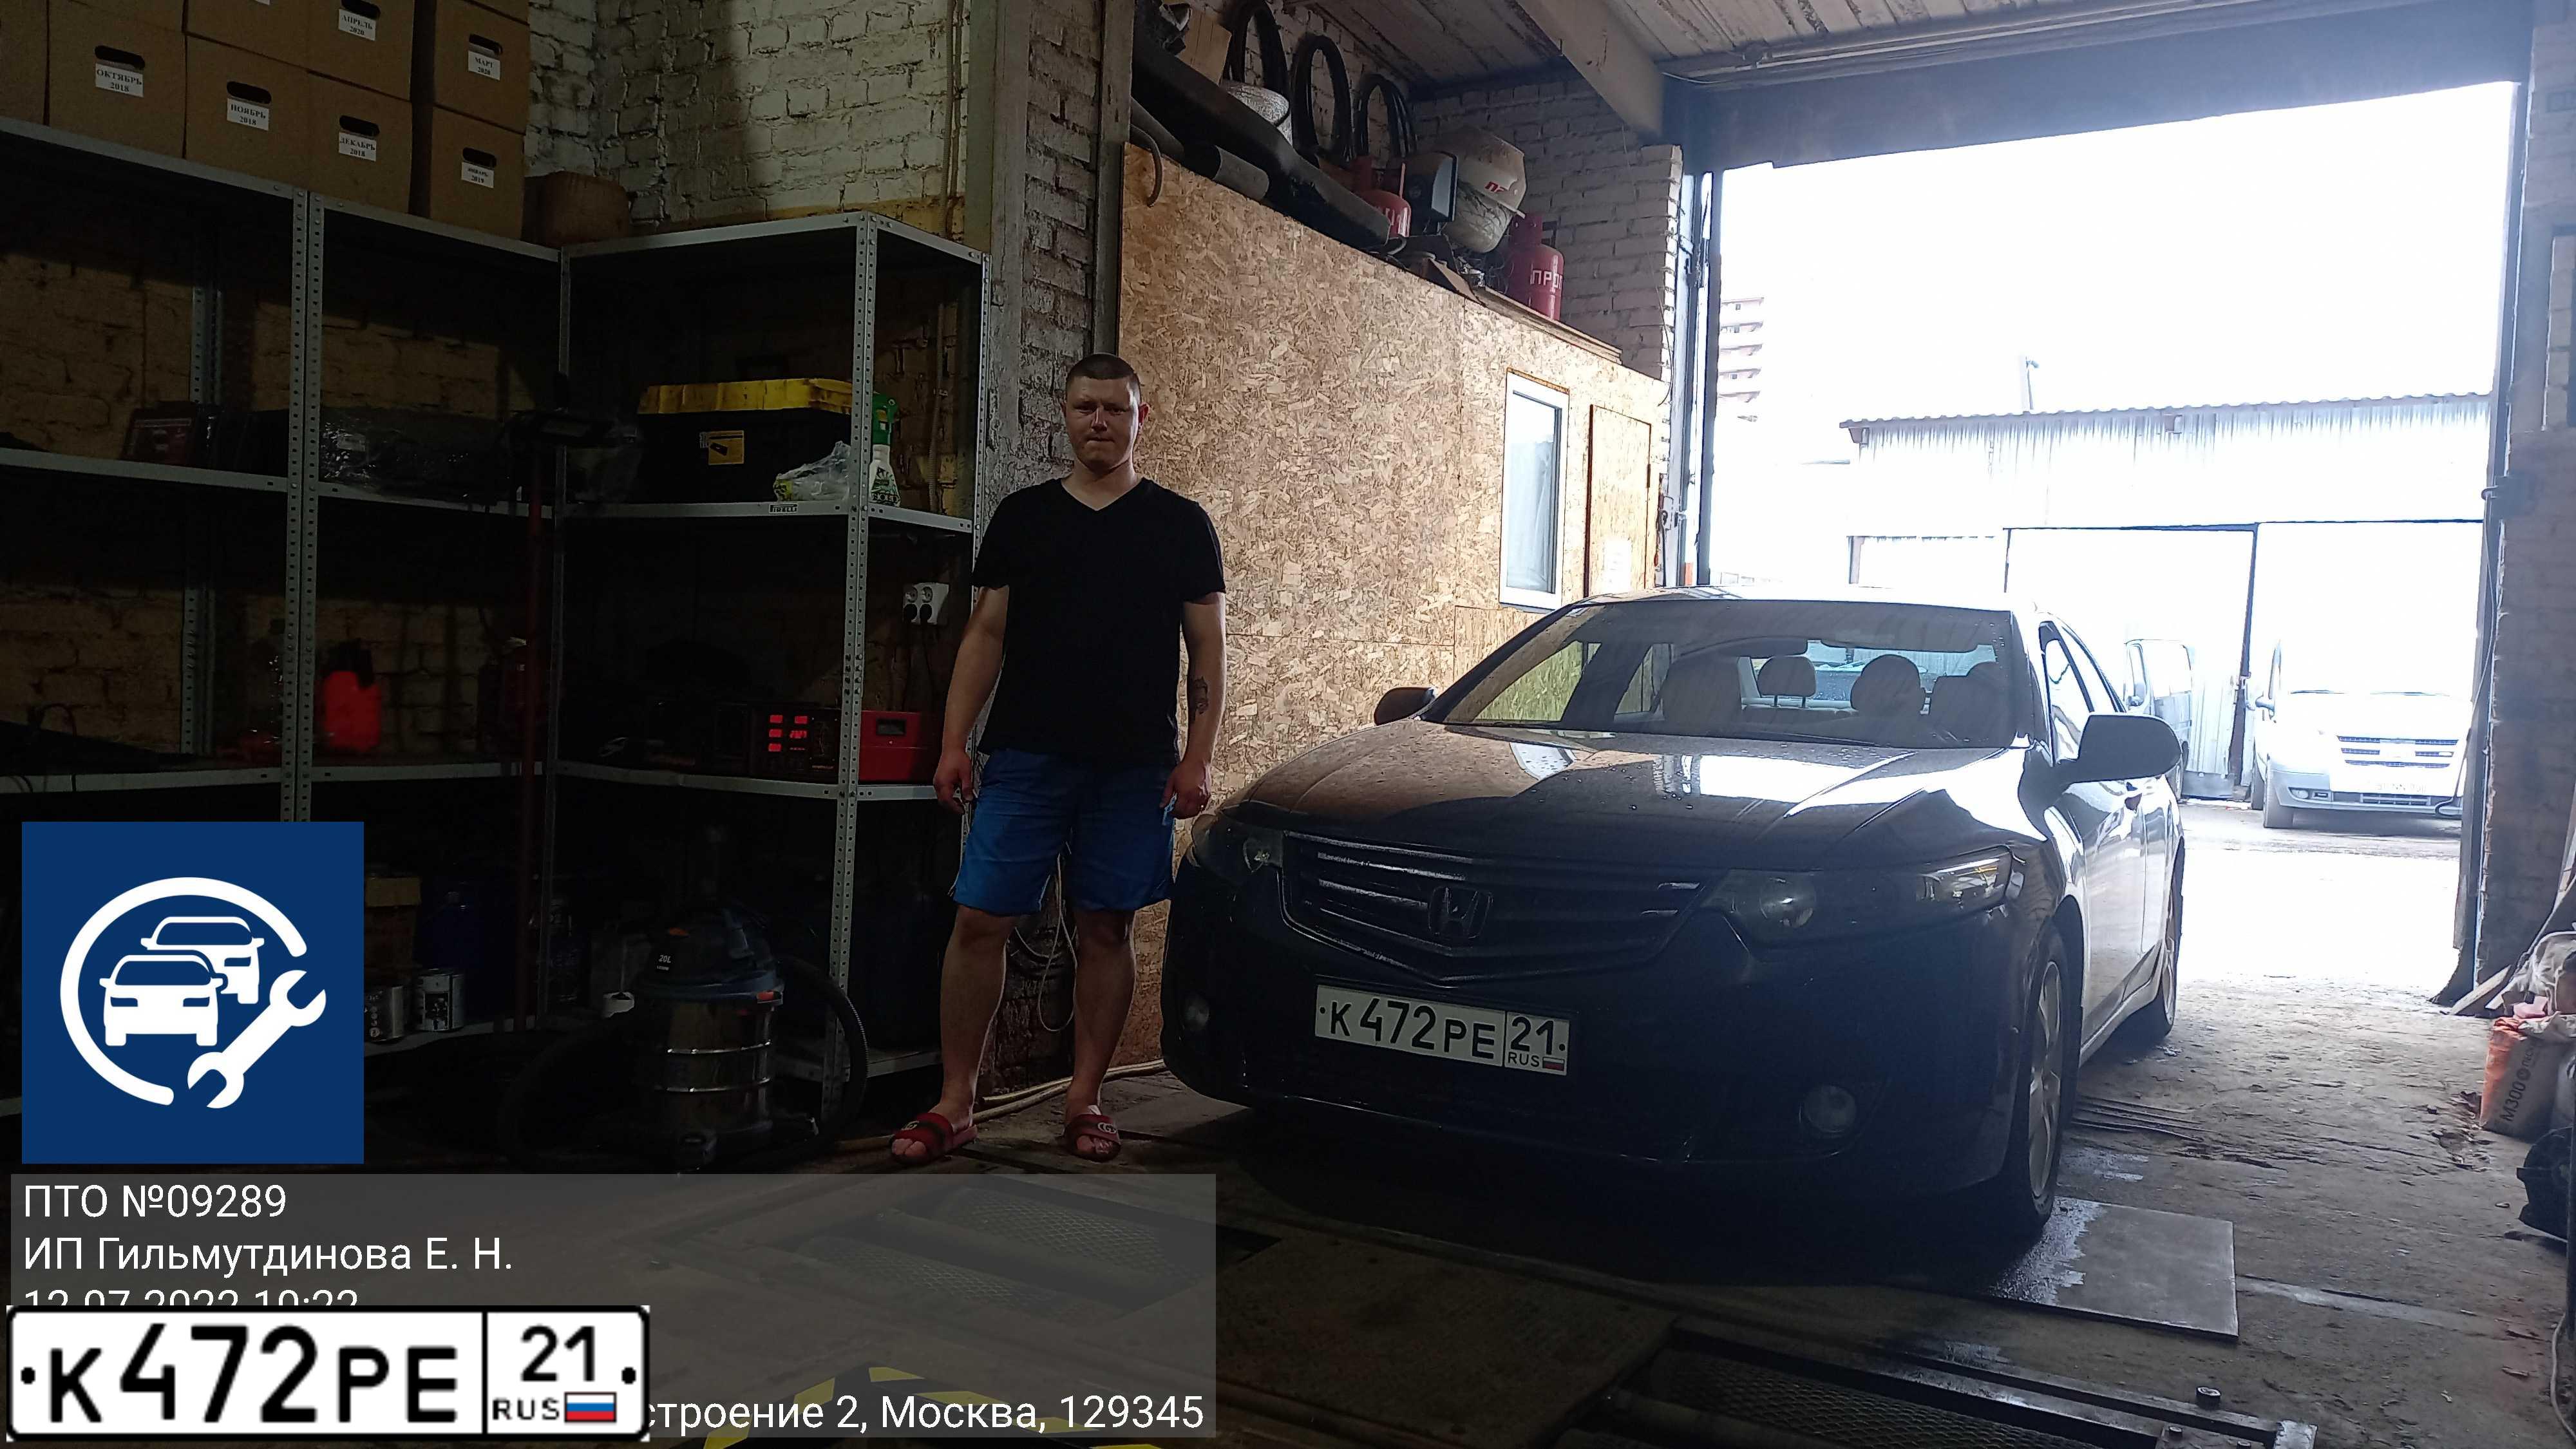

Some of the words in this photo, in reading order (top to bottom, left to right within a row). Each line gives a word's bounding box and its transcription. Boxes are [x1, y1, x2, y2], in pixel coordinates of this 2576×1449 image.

[97, 68, 142, 85] ОКТЯБРЬ
[110, 82, 129, 92] 2018
[231, 103, 266, 119] НОЯБРЬ
[239, 115, 256, 126] 2018
[770, 504, 797, 513] PIRELLI
[1331, 998, 1495, 1059] К472РЕ
[1511, 1016, 1554, 1055] 21
[1508, 1052, 1540, 1067] RUS
